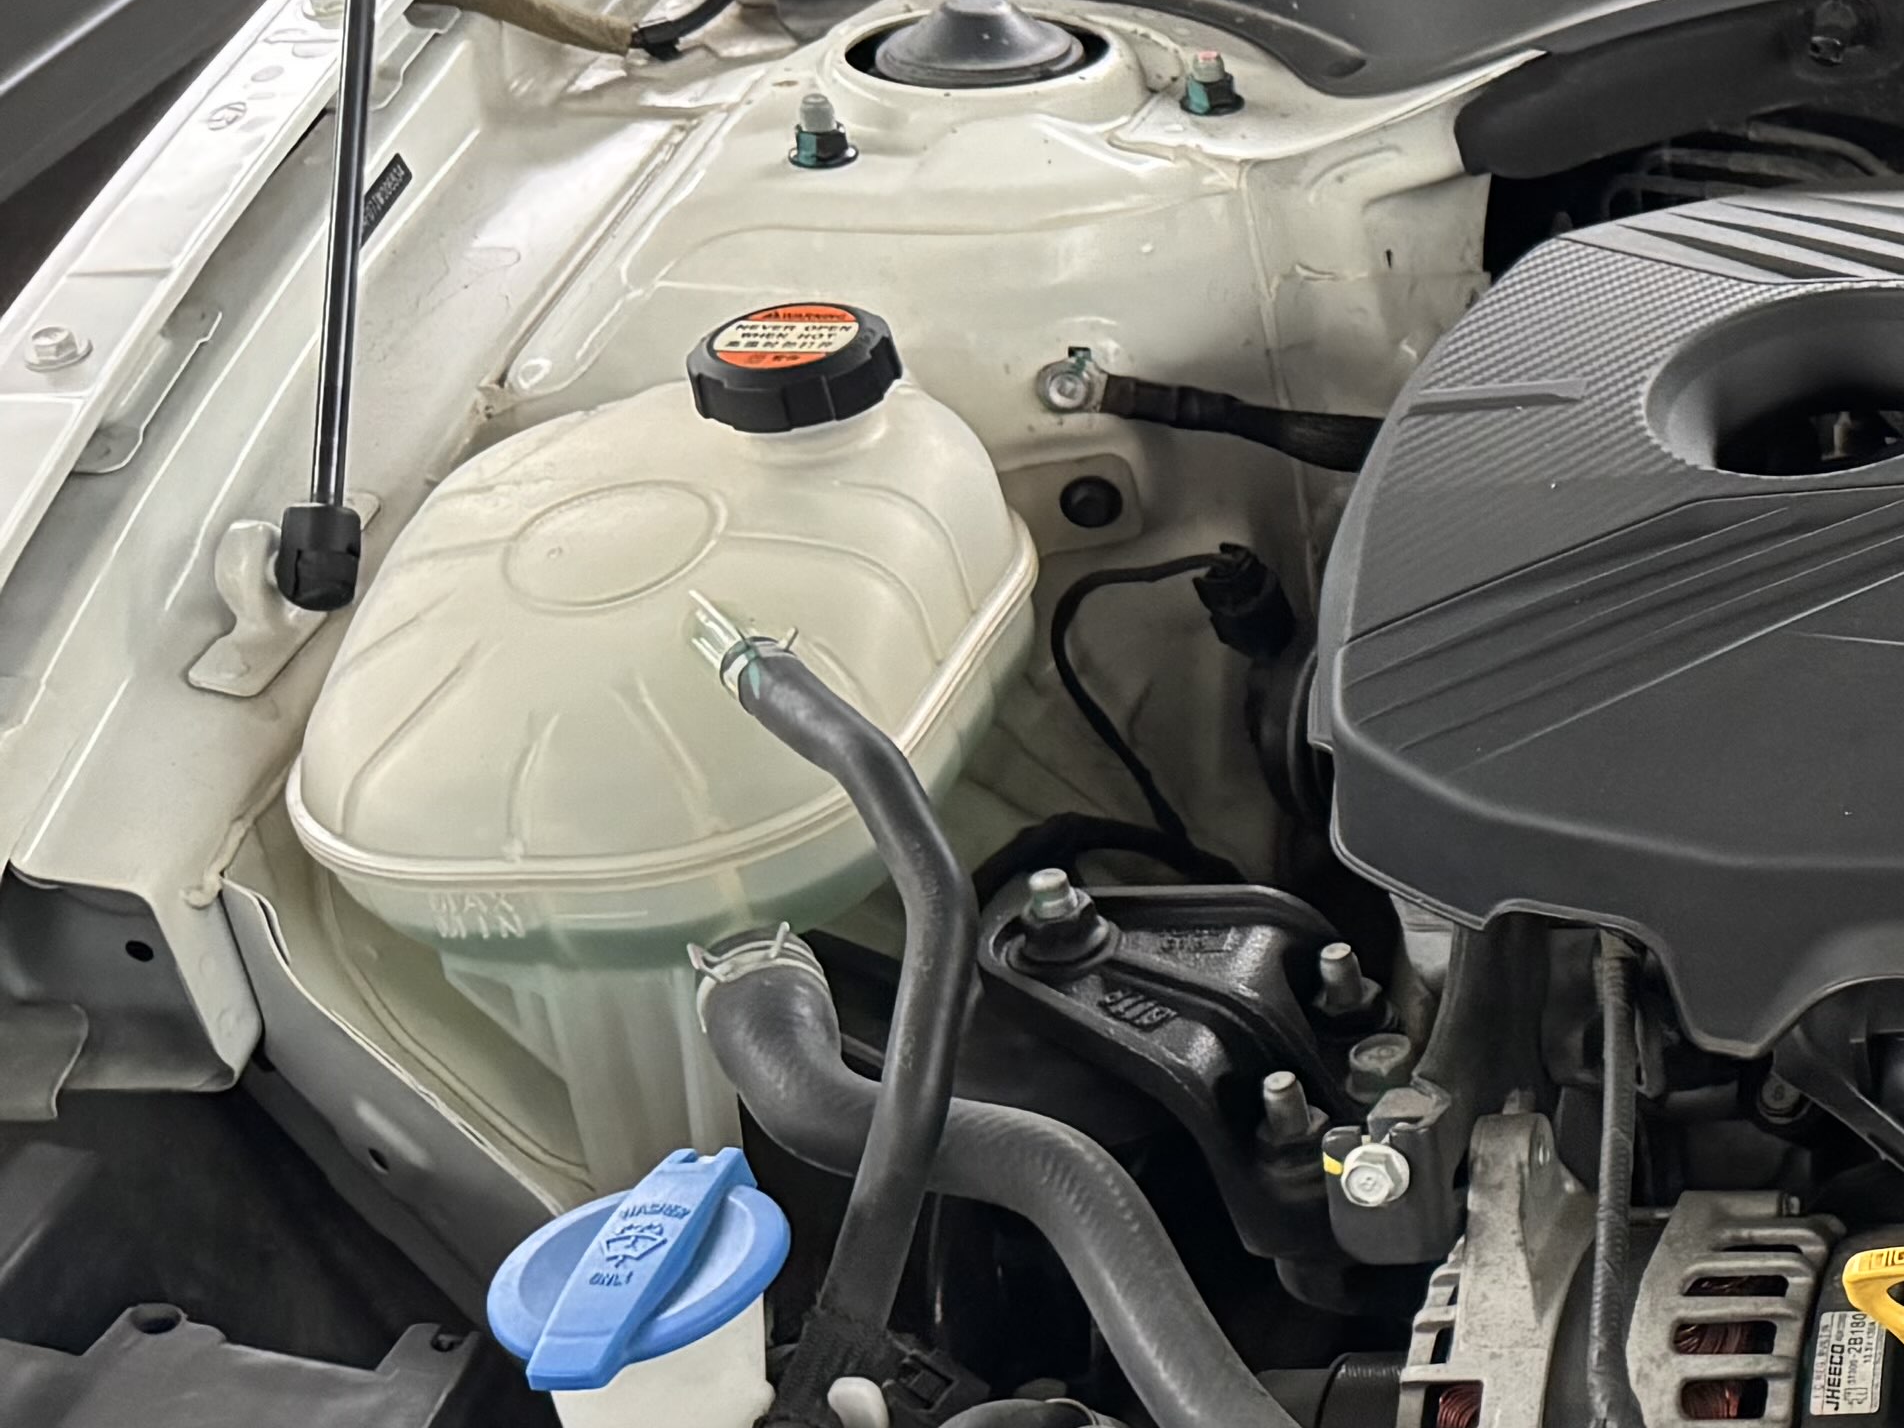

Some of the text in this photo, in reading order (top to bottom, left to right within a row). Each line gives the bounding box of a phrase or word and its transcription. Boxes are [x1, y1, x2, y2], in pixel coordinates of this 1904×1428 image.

[735, 324, 853, 332] NEVER OPEN
[740, 332, 789, 340] WHEN
[429, 890, 515, 913] MAX
[434, 914, 526, 939] MIN
[1825, 1343, 1845, 1411] JHEECO
